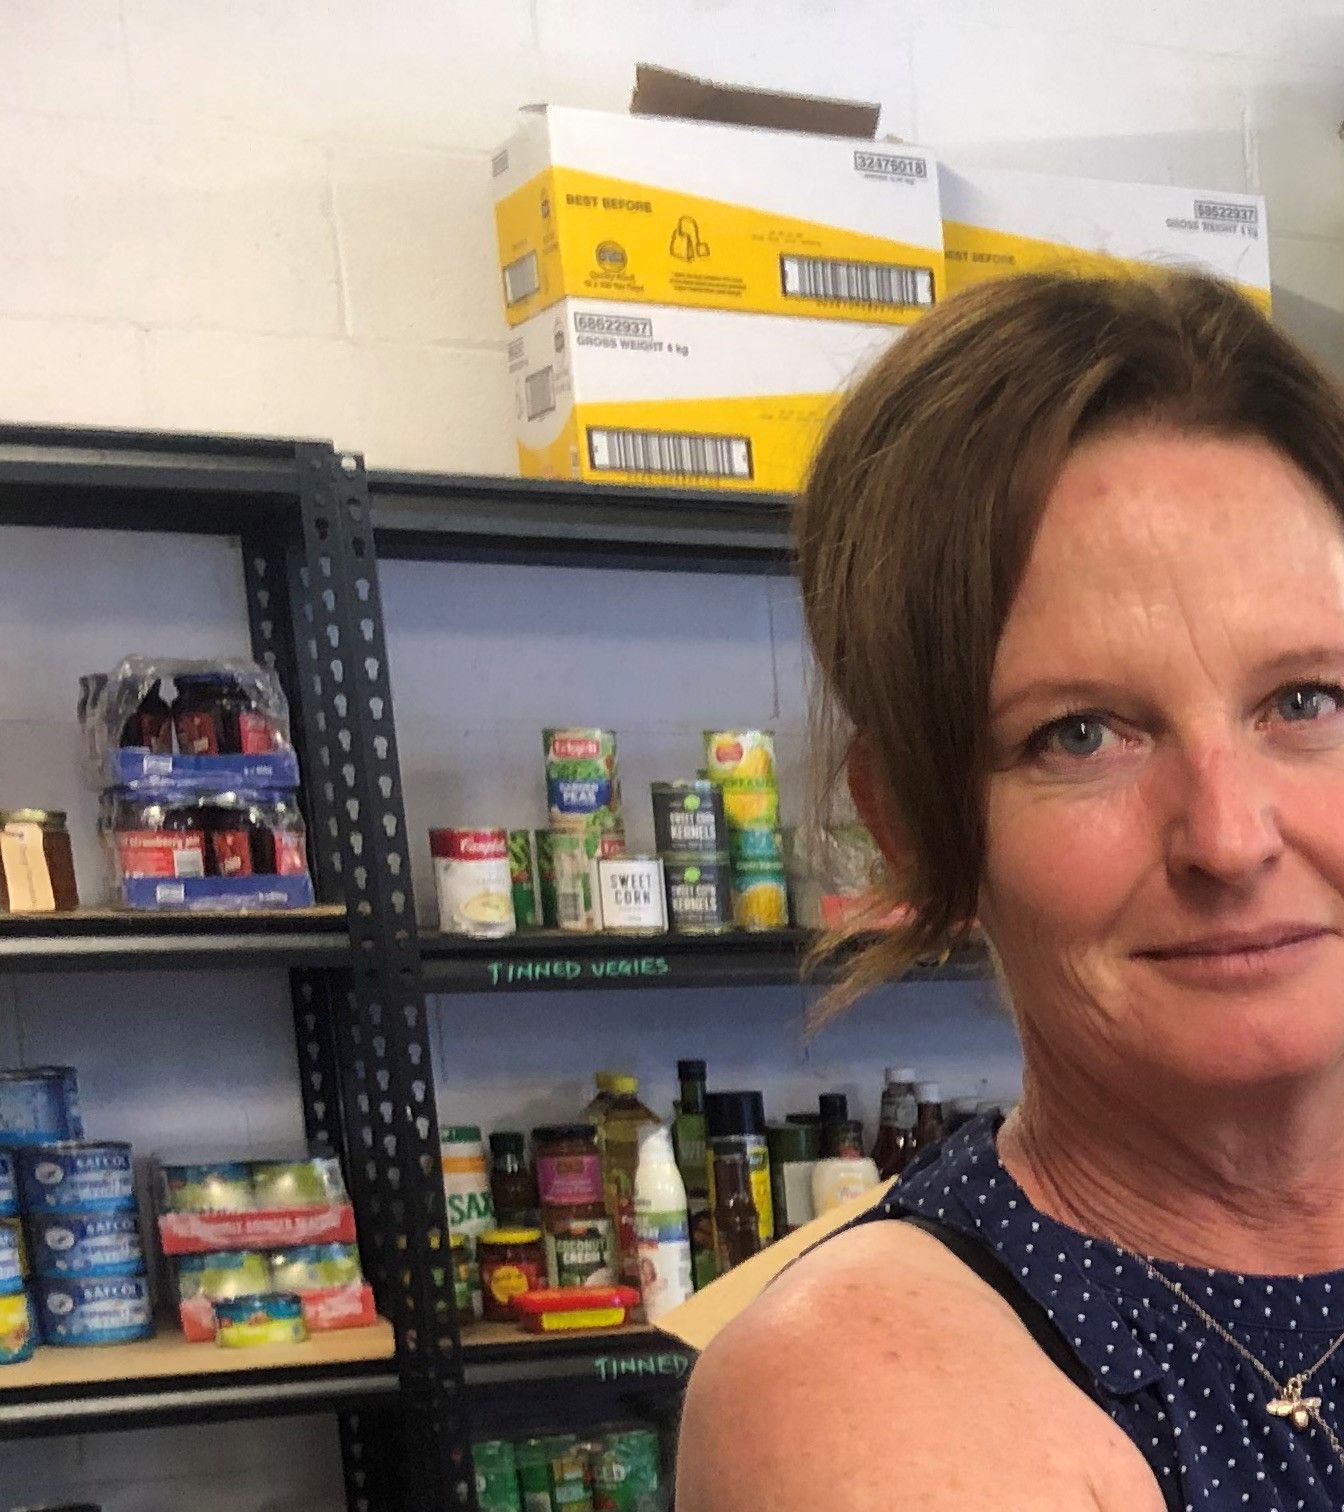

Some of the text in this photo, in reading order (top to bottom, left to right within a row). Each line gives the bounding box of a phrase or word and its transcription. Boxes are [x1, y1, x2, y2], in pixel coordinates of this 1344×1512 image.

[565, 193, 653, 213] BEST BEFORE
[577, 335, 619, 350] GROSS
[620, 339, 664, 353] WEIGHT
[610, 873, 652, 890] SWEET
[613, 889, 651, 906] CORN
[488, 961, 582, 987] TINNED
[594, 1353, 690, 1382] TINNED
